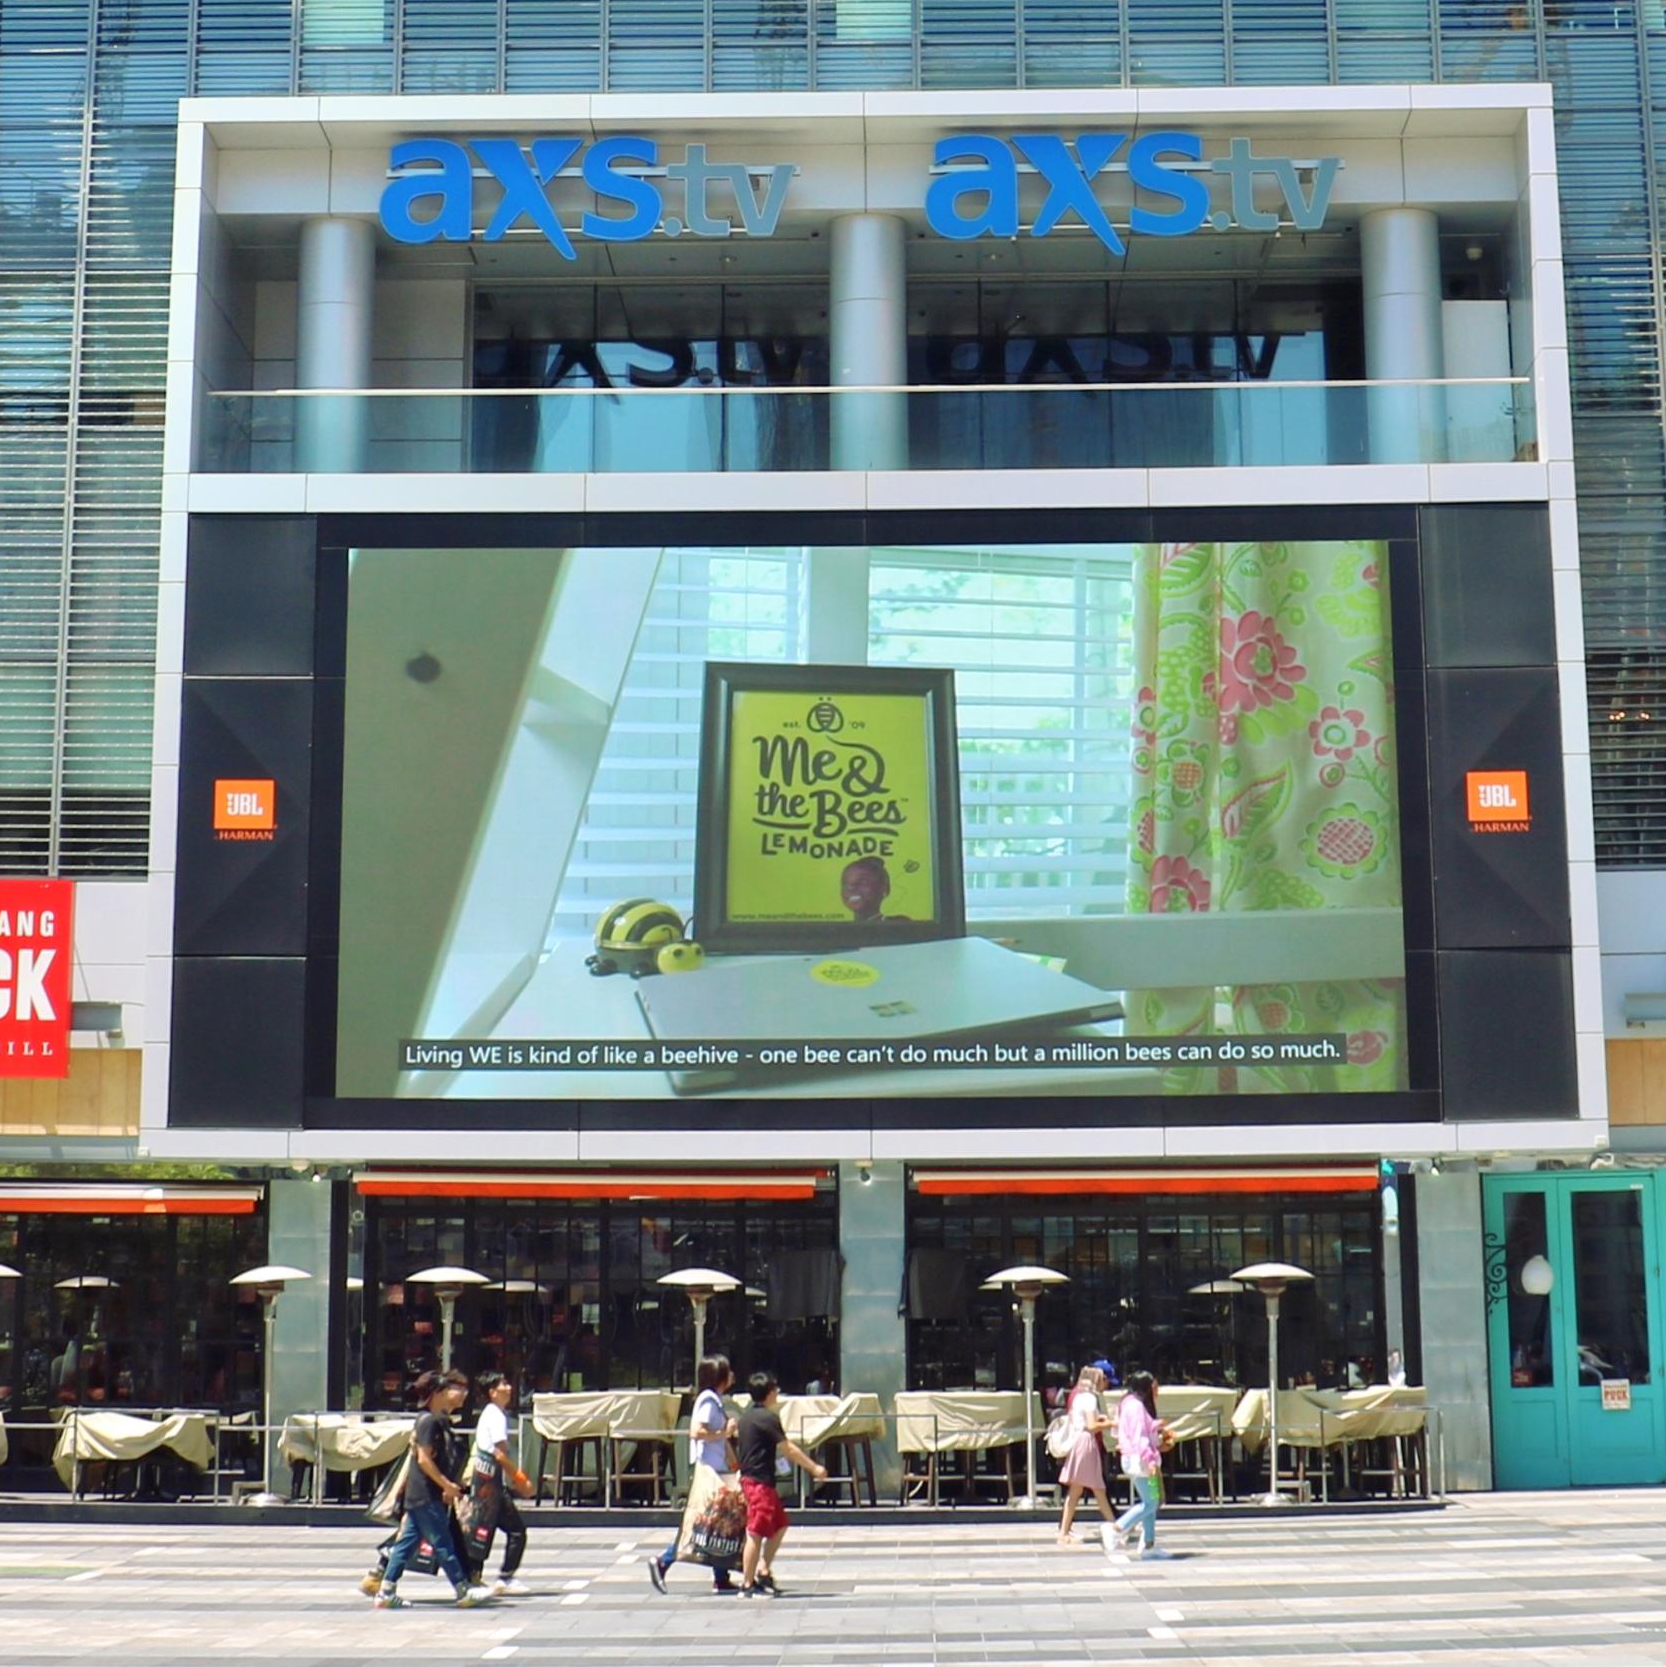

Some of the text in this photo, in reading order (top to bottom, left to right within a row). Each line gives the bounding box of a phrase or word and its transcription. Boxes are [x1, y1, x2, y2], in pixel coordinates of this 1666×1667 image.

[379, 133, 796, 261] axs.tv
[926, 129, 1339, 256] axs.tv
[752, 734, 890, 797] Me &
[226, 792, 264, 816] JBL
[1478, 784, 1518, 808] JBL
[755, 782, 907, 839] the Bees
[219, 830, 274, 841] HARMAN
[1473, 822, 1530, 833] HARMAN
[761, 832, 894, 859] LEMONADE
[406, 1045, 463, 1067] Living
[469, 1046, 501, 1064] WE
[508, 1045, 523, 1064] is
[529, 1044, 572, 1064] kind
[577, 1044, 599, 1064] of
[604, 1044, 637, 1064] like
[662, 1044, 739, 1064] beehive
[760, 1048, 797, 1064] one
[805, 1044, 841, 1064] bee
[846, 1044, 894, 1063] can't
[900, 1044, 927, 1063] do
[934, 1043, 988, 1063] much
[995, 1043, 1028, 1062] but
[1052, 1042, 1120, 1062] million
[1126, 1042, 1171, 1061] bees
[1178, 1046, 1212, 1060] can
[1218, 1041, 1245, 1060] do
[1251, 1045, 1273, 1060] so
[1281, 1040, 1341, 1059] much.
